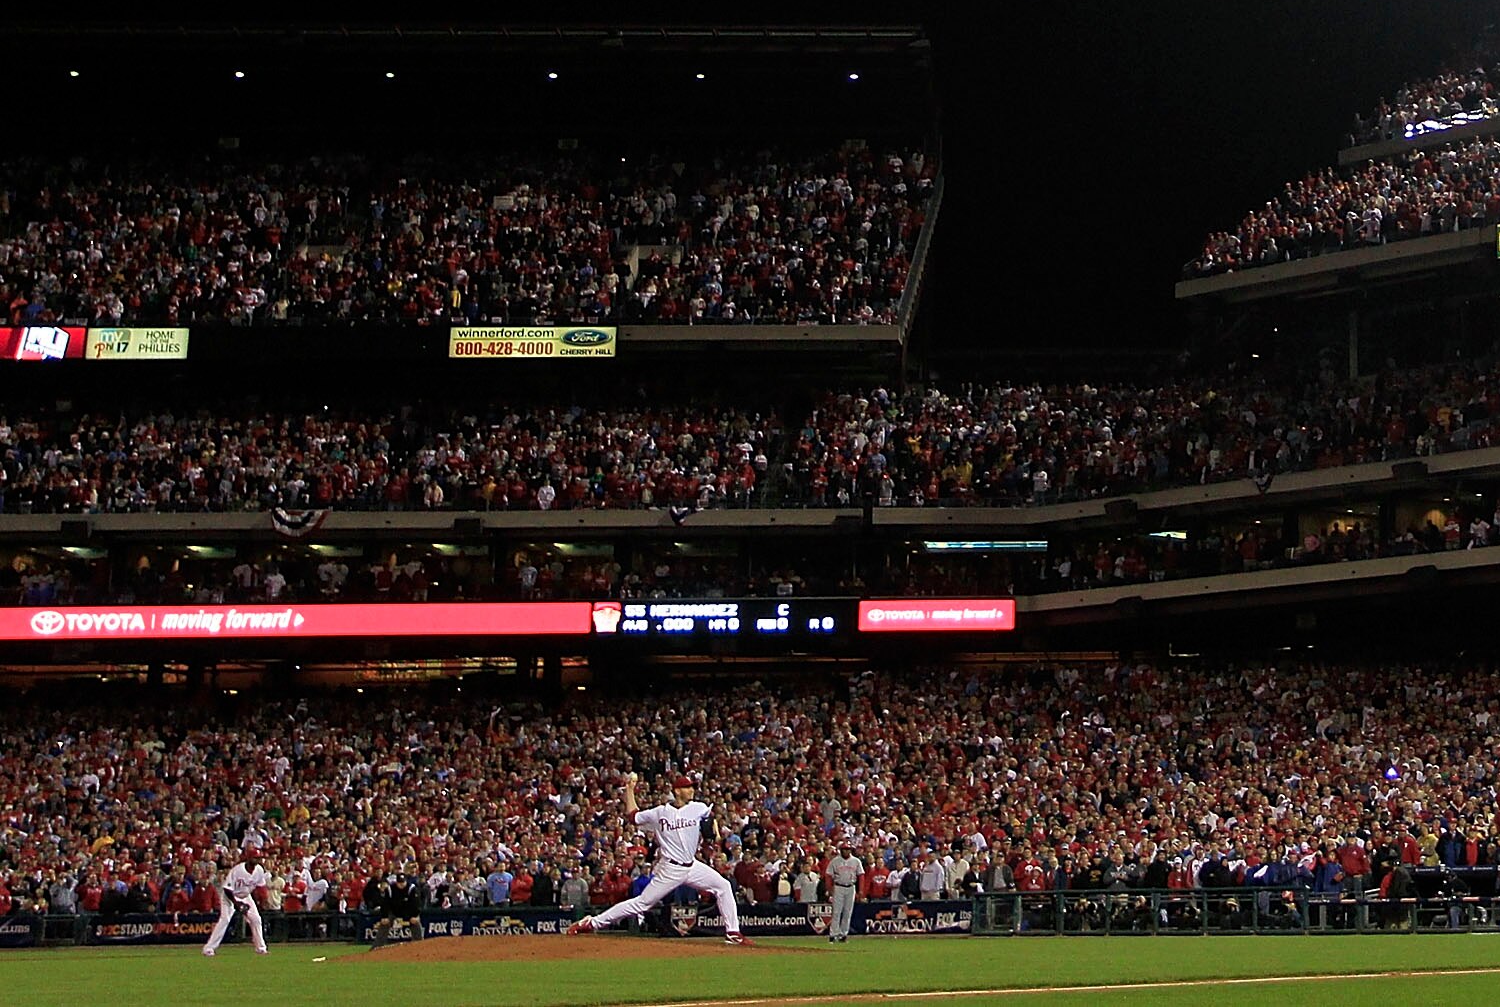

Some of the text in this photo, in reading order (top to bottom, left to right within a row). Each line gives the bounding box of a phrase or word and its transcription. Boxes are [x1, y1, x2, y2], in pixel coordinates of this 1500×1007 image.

[146, 330, 176, 339] HOME
[458, 328, 554, 338] winnerford.com
[571, 332, 600, 343] Ford
[117, 341, 129, 353] 17
[138, 343, 180, 353] PHILLIES
[455, 342, 554, 356] 800-428-4000
[560, 348, 613, 356] CHERRY HILL
[777, 604, 789, 616] C
[885, 610, 925, 620] TOYOTA
[66, 608, 293, 633] TOYOTA moving forward
[656, 618, 694, 631] .000
[659, 818, 697, 833] Phillies
[671, 907, 697, 917] MLB
[809, 905, 833, 915] MLB
[428, 921, 448, 934] FOX
[537, 920, 557, 933] FOX
[865, 918, 934, 933] POSTSEASON
